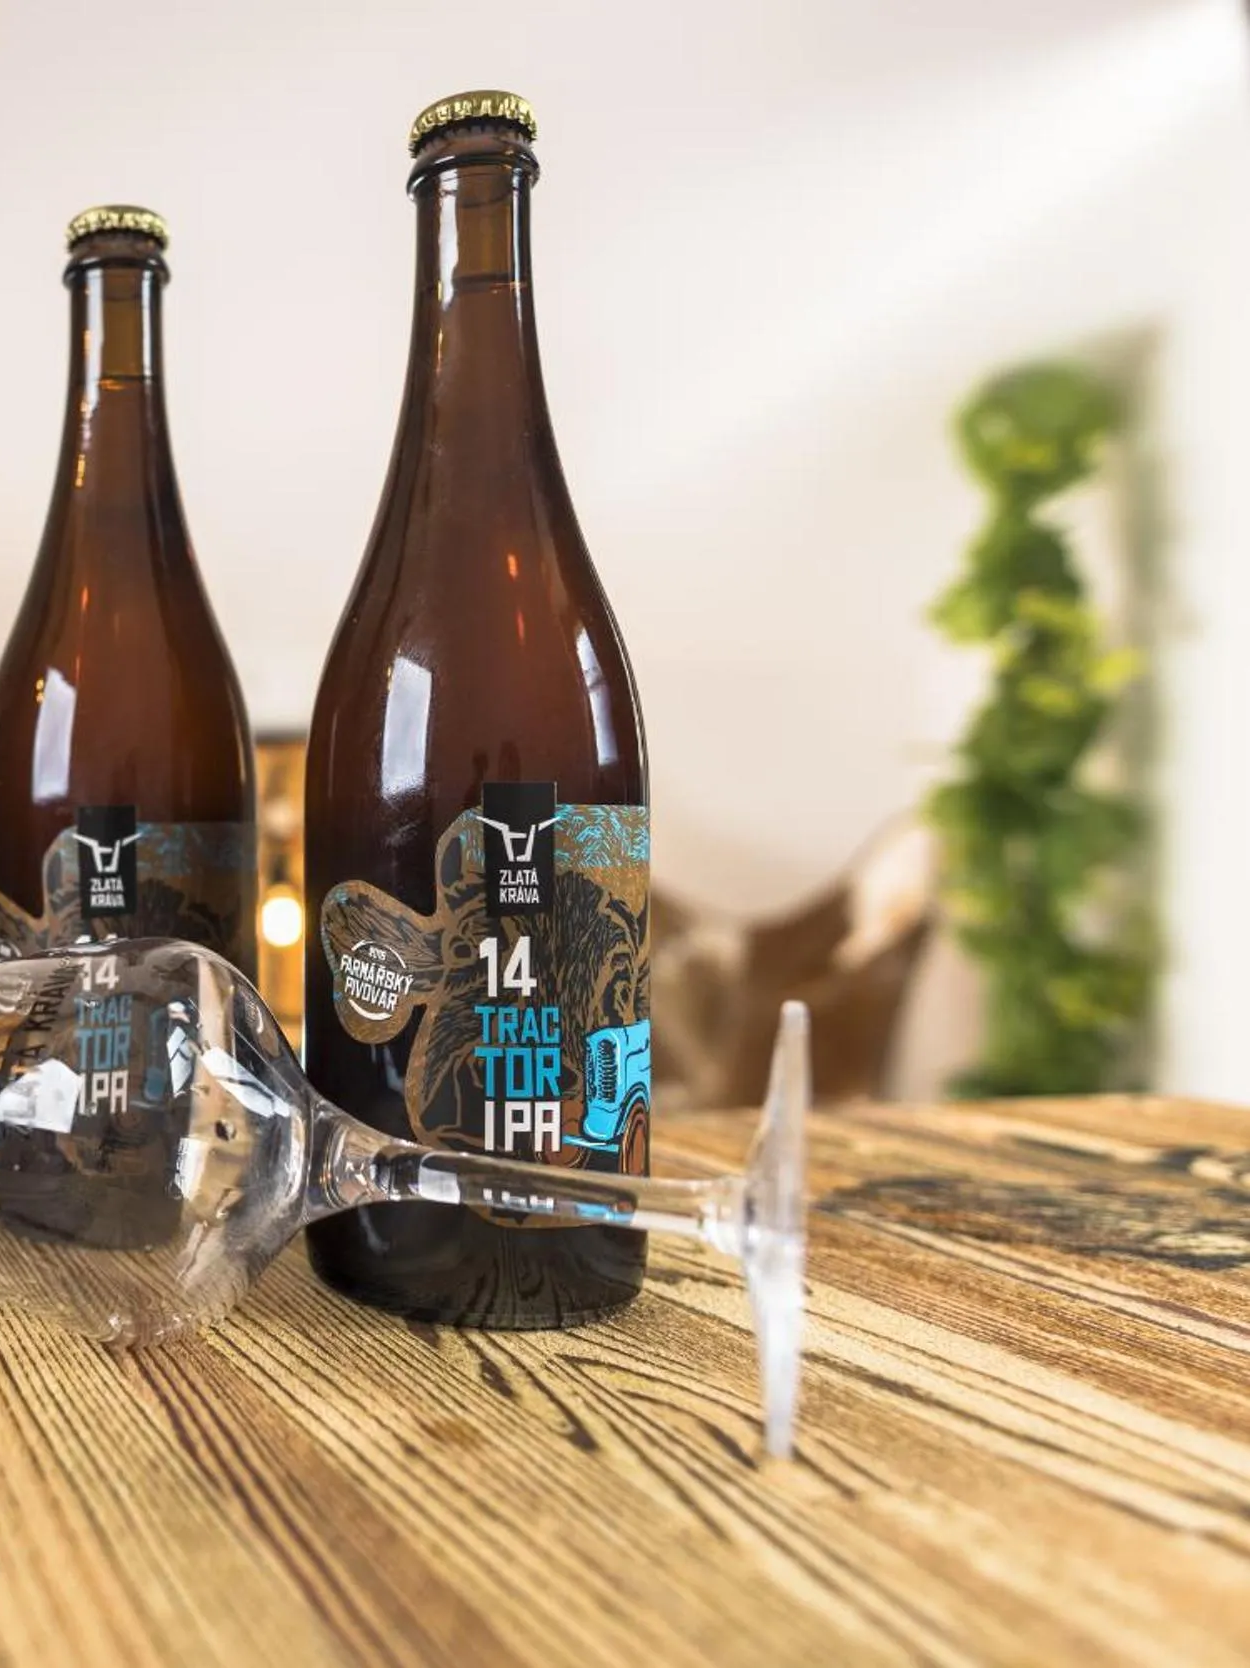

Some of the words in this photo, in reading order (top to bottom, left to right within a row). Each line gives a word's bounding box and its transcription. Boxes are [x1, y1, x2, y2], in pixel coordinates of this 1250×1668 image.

[90, 877, 124, 892] ZLATÁ
[499, 868, 539, 886] ZLATÁ
[499, 886, 540, 904] KRÁVA
[90, 893, 125, 907] KRÁVA
[77, 954, 119, 991] 14
[479, 936, 537, 998] 14
[74, 994, 133, 1027] TRAC
[344, 976, 399, 1011] PIVOVAR
[474, 1006, 561, 1044] TRAC
[74, 1027, 131, 1070] TOR
[474, 1047, 562, 1098] TOR
[78, 1070, 129, 1115] IPA
[484, 1101, 561, 1152] IPA
